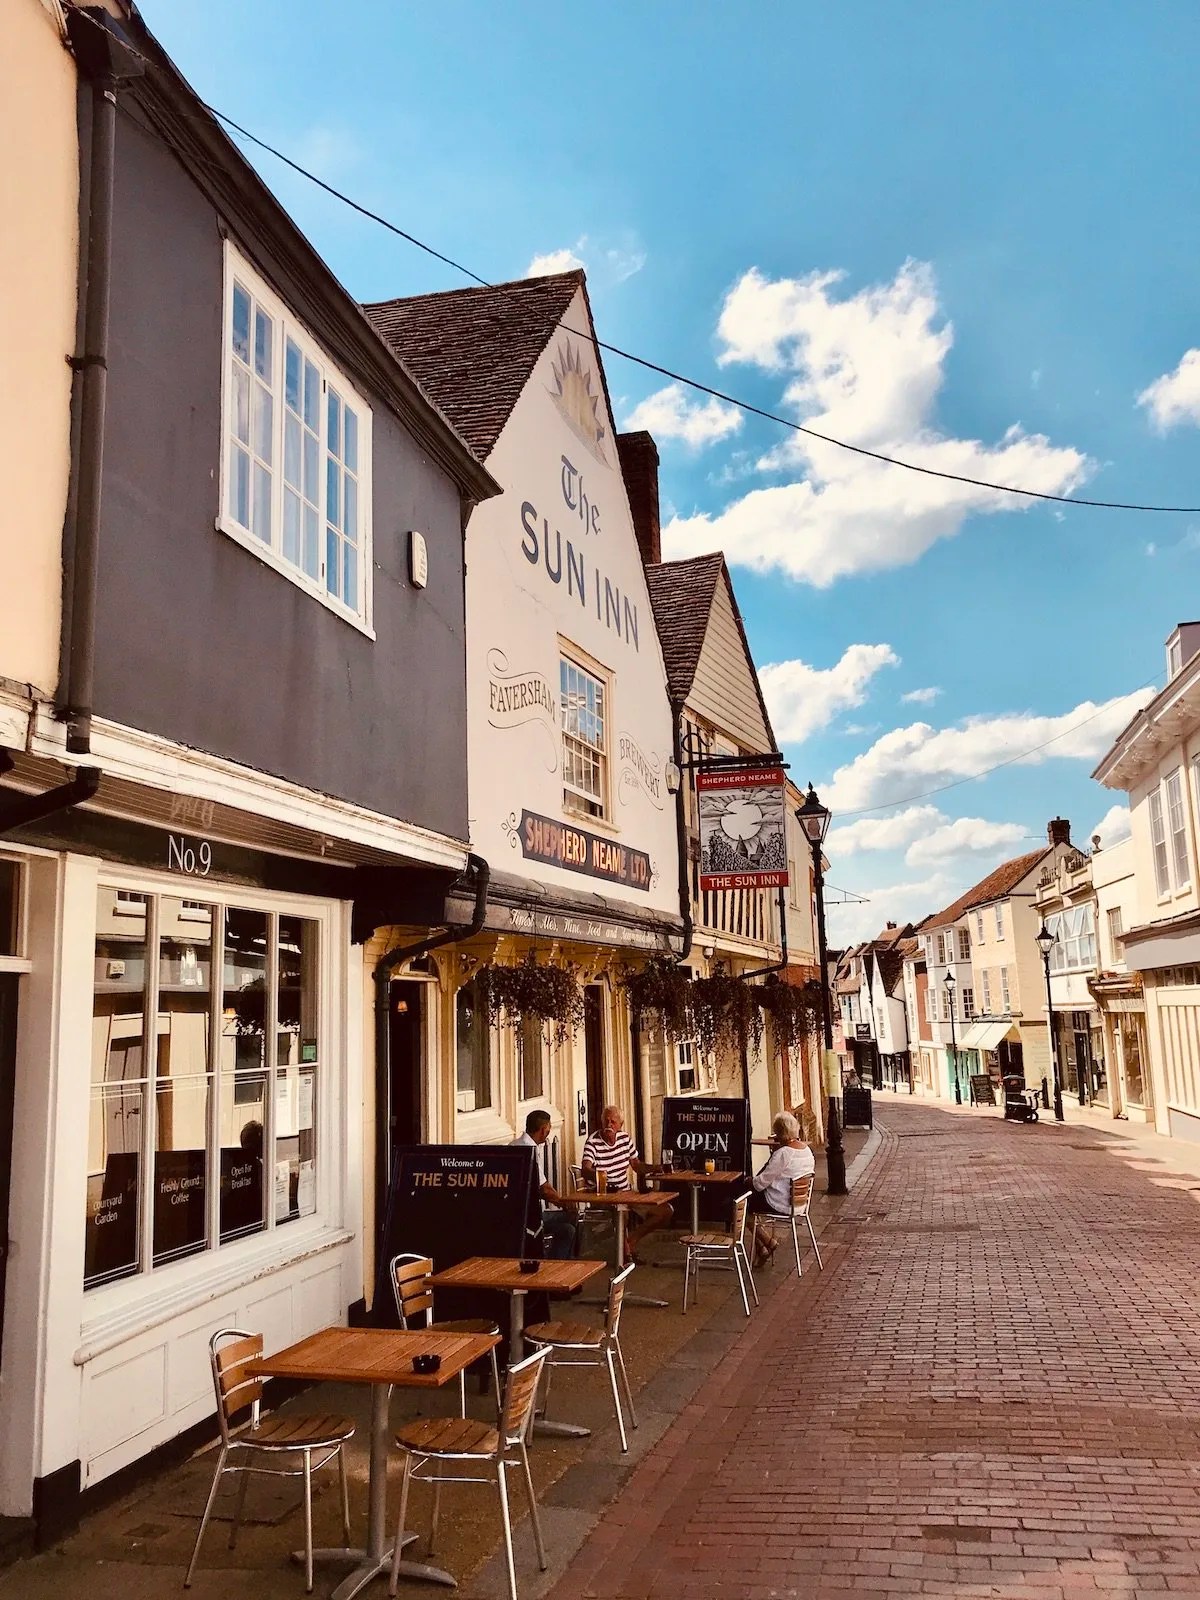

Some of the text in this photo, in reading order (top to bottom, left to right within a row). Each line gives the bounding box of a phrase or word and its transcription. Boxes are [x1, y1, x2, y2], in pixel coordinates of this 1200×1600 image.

[561, 454, 601, 535] The
[521, 501, 586, 608] SUN
[595, 567, 639, 653] INN
[489, 680, 556, 724] FAVERSHAM
[619, 738, 660, 799] BREWERY
[701, 773, 777, 785] SHEPHERD NEAME
[525, 817, 650, 884] SHEPHERD NEAME LTD.
[709, 874, 780, 888] THE SUN INN
[677, 1113, 735, 1122] THE SUN INN
[676, 1131, 729, 1152] OPEN
[440, 1158, 484, 1168] Welcome to
[231, 1166, 244, 1178] Open
[160, 1175, 200, 1193] Freshly Ground
[413, 1173, 509, 1188] THE SUN INN
[171, 1192, 190, 1205] Coffee
[95, 1211, 118, 1225] Garden
